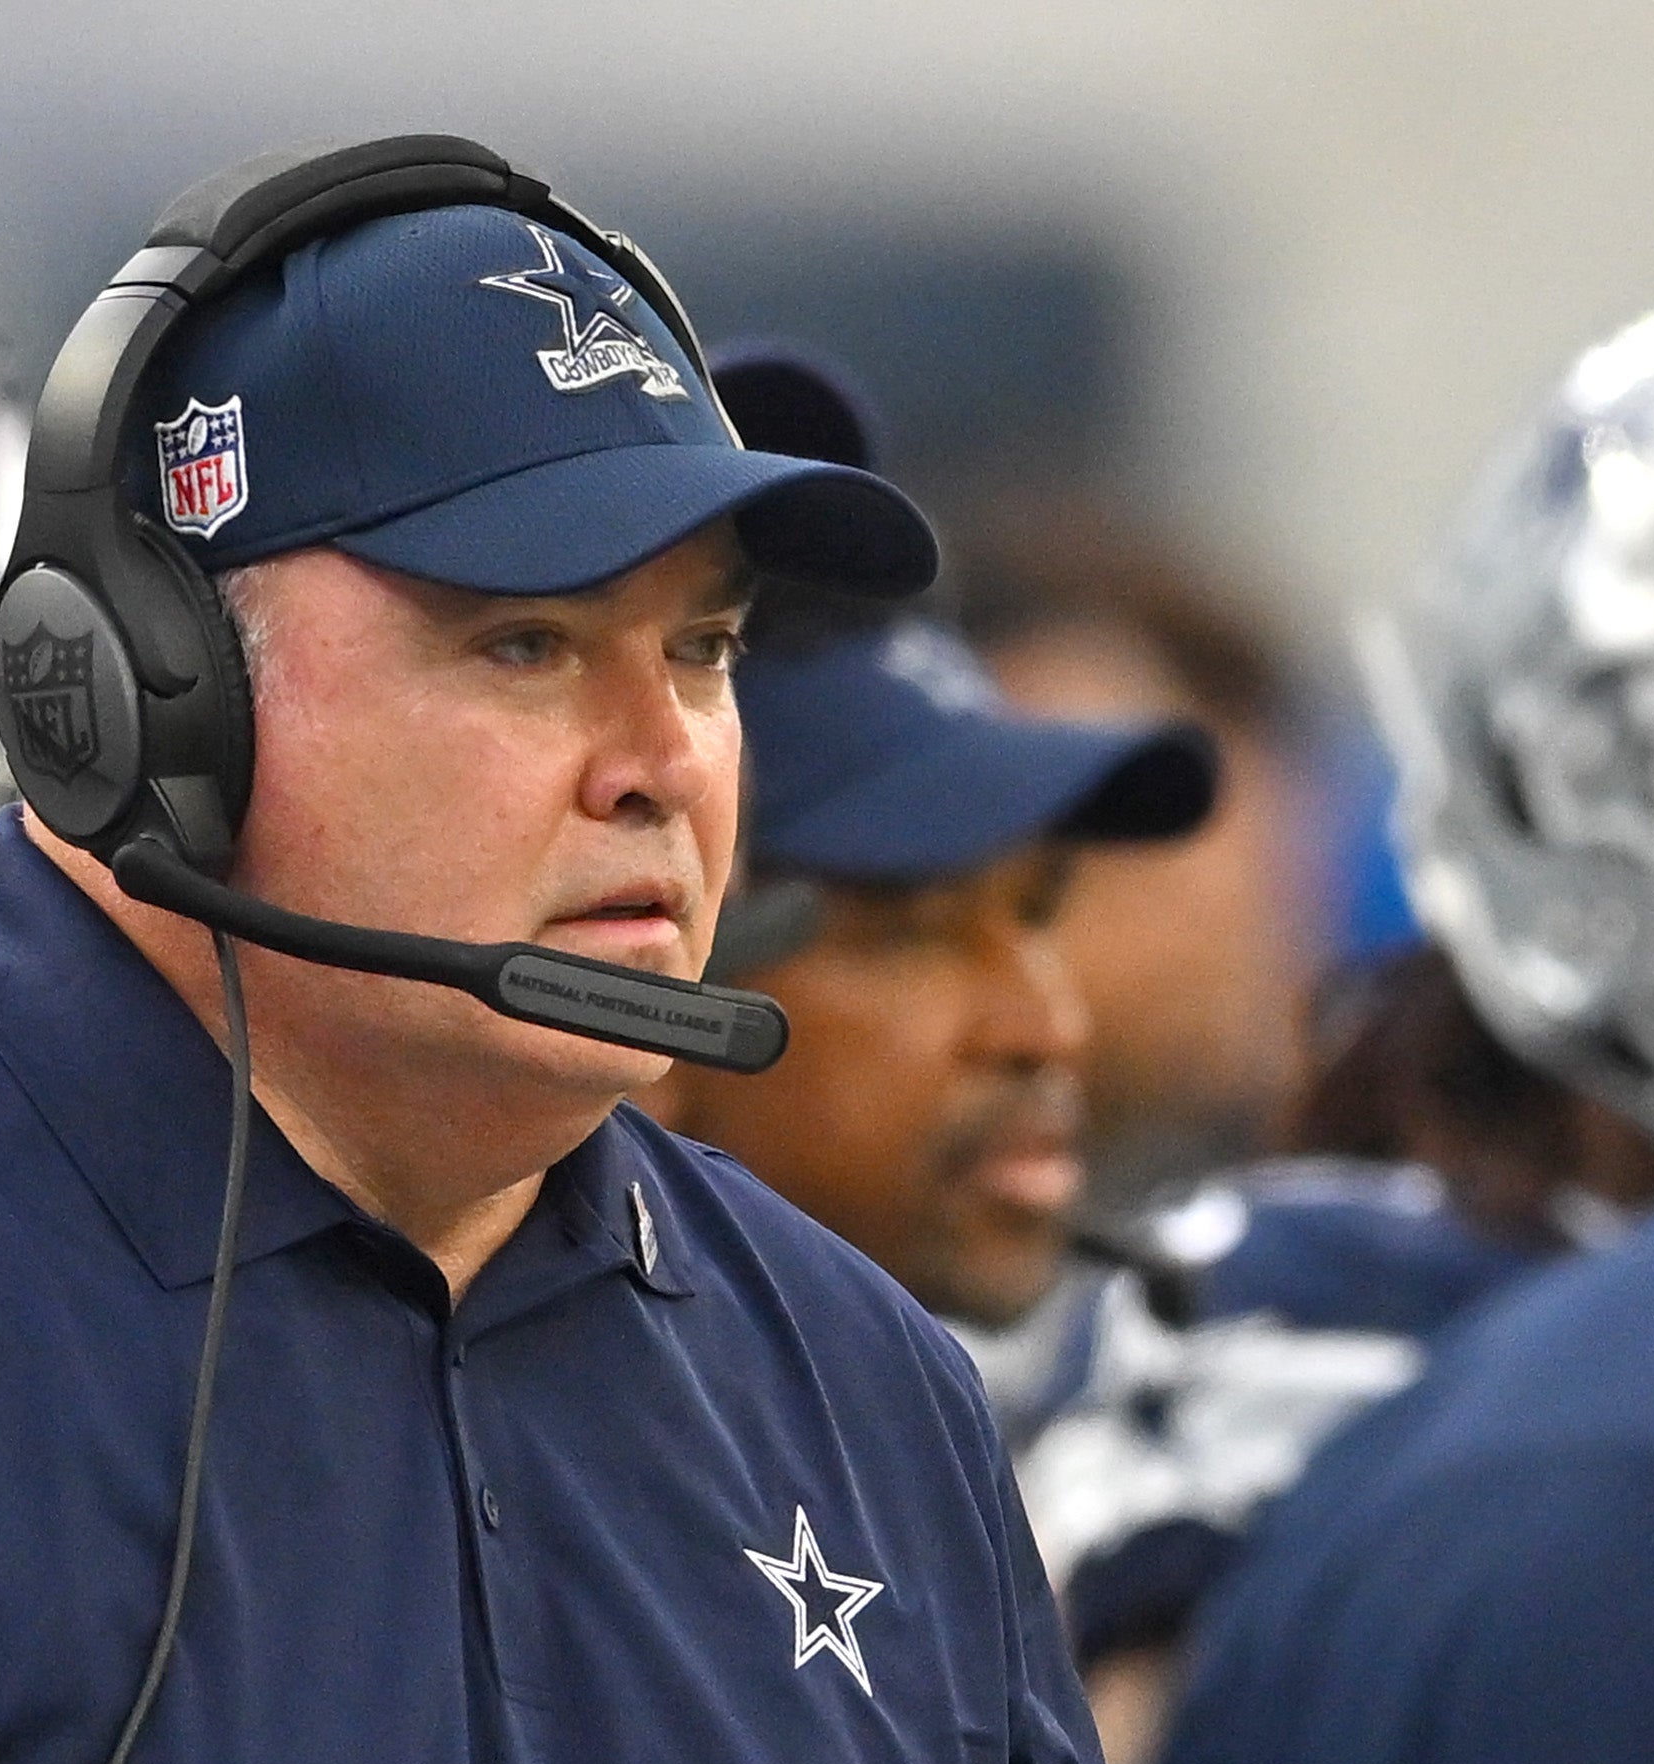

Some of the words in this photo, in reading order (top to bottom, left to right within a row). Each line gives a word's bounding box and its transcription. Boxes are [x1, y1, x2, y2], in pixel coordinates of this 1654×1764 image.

[172, 457, 234, 515] NFL
[11, 693, 93, 771] NFL
[507, 970, 583, 1003] NATIONAL
